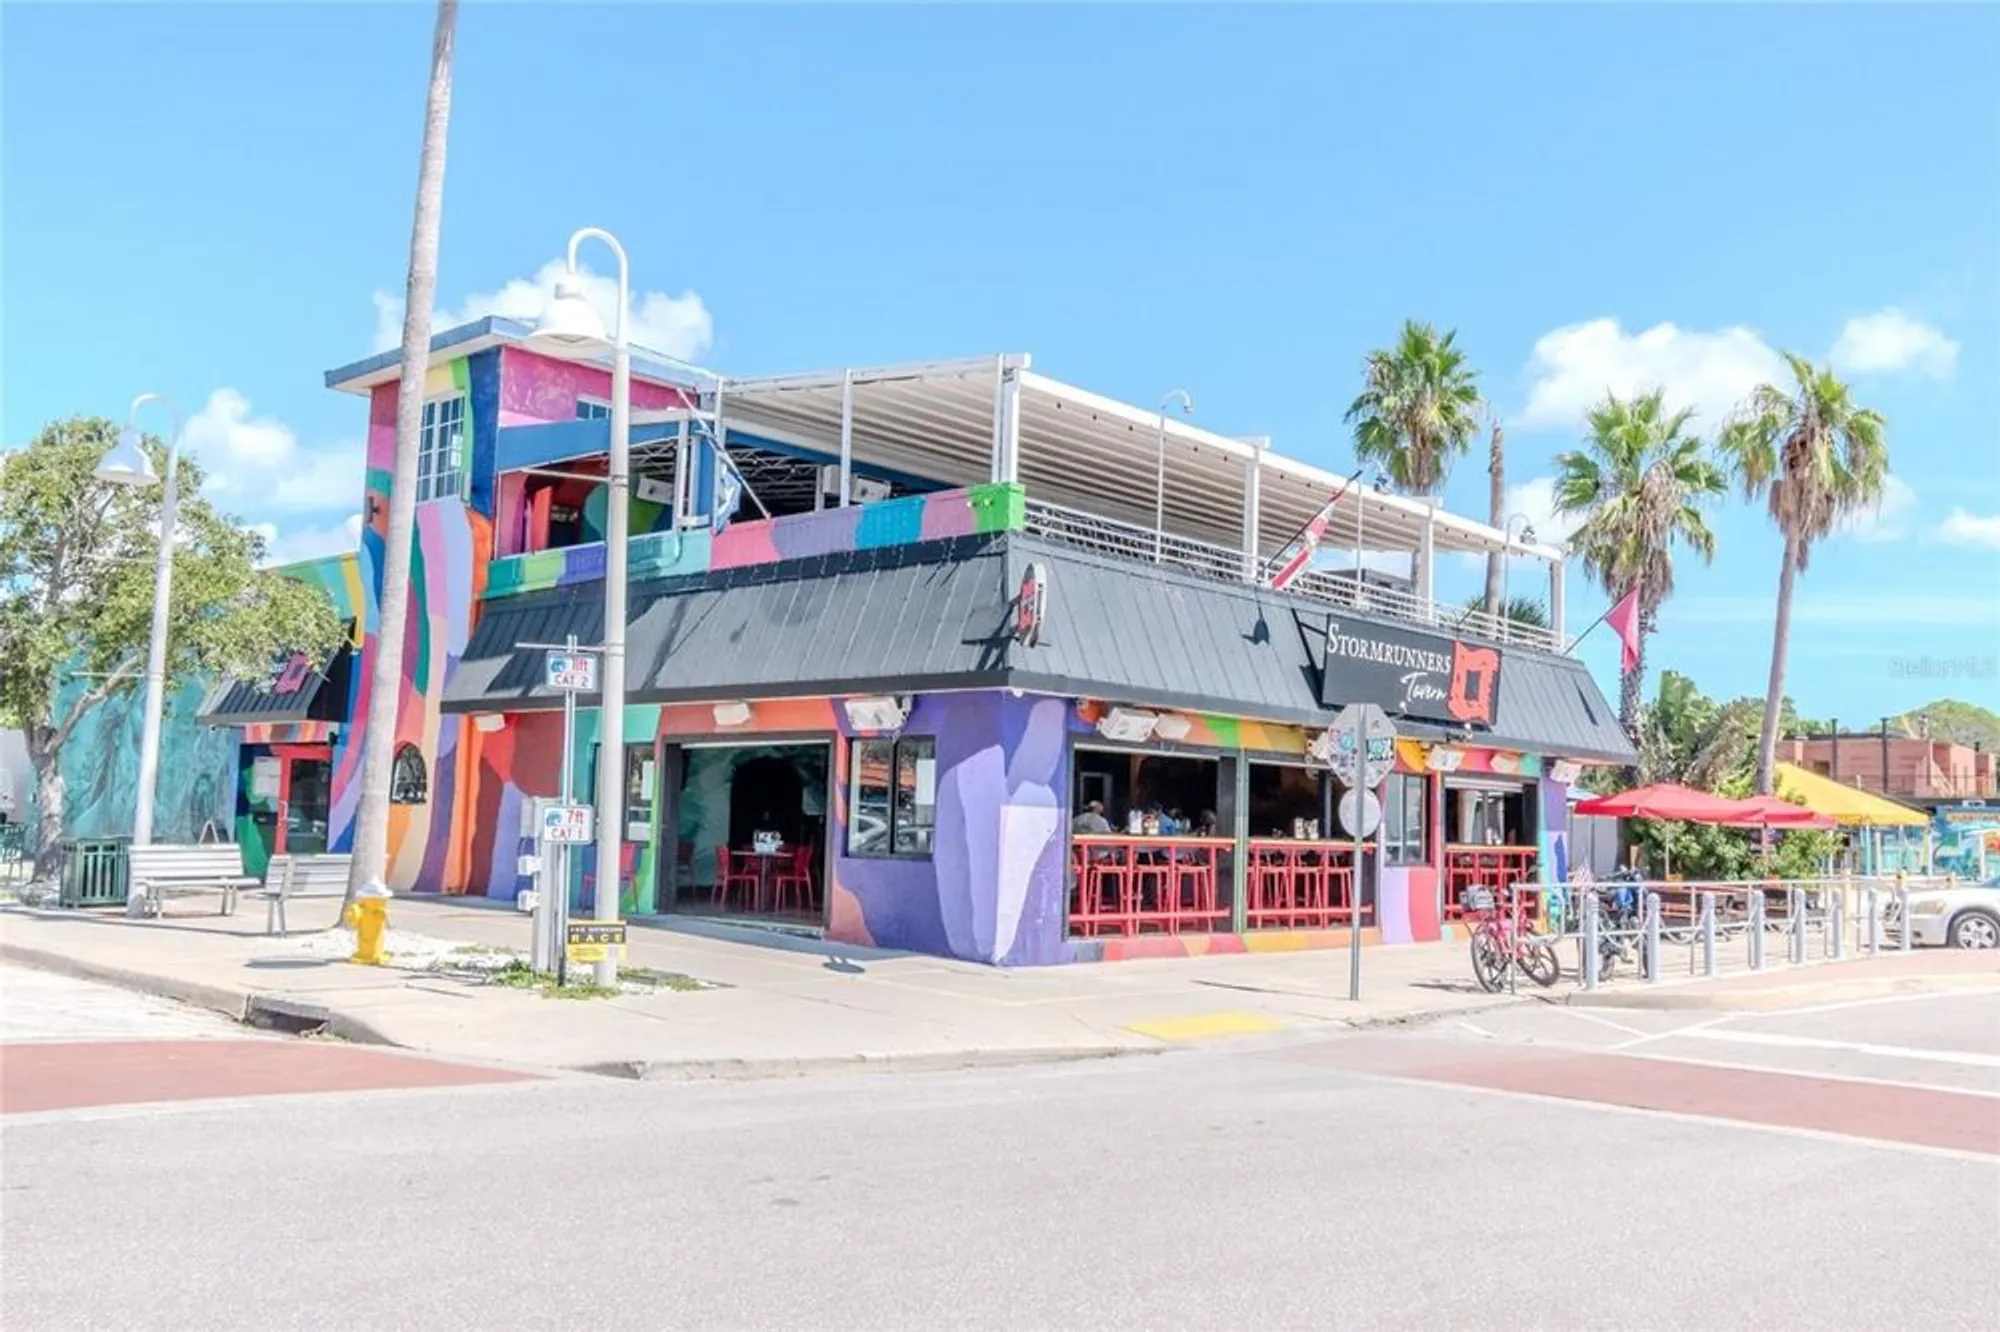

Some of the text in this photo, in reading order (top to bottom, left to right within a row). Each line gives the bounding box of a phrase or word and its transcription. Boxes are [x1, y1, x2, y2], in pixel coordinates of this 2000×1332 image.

[1326, 623, 1453, 675] STORMRUNNERS
[554, 674, 589, 687] CAT 2
[1400, 671, 1448, 702] Tavern
[566, 809, 583, 824] 7ft
[552, 827, 584, 838] CAT 1
